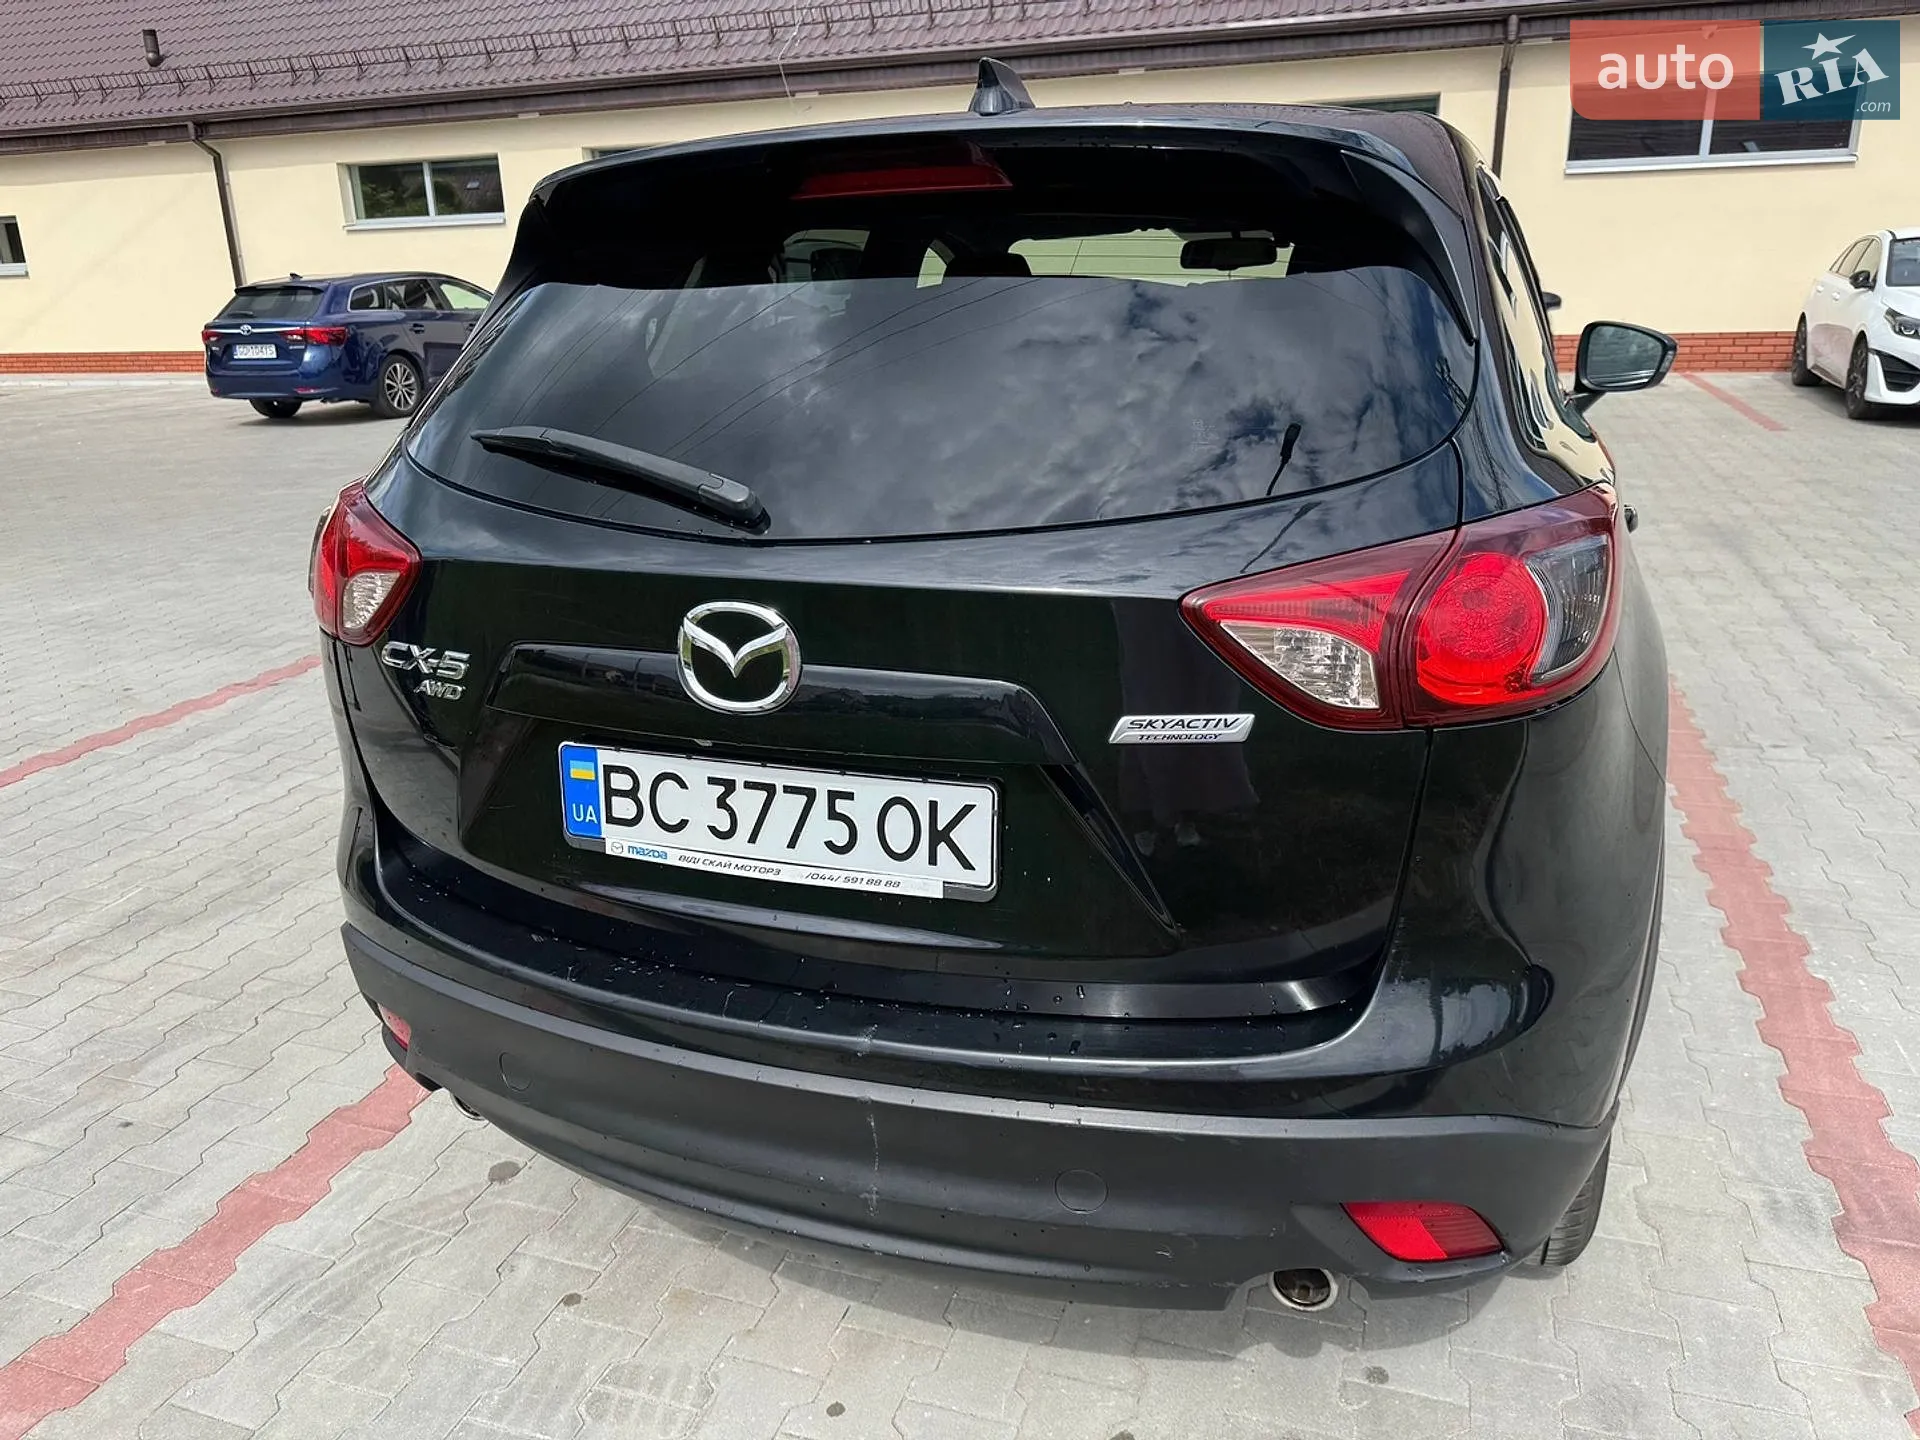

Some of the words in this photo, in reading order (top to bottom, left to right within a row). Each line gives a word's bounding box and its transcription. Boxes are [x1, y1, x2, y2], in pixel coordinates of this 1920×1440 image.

[381, 640, 472, 680] CX-5
[413, 679, 466, 700] AWD
[1127, 717, 1240, 730] SKYACTIV
[1138, 733, 1222, 741] TECHNOLOGY
[571, 802, 599, 824] UA
[602, 764, 690, 833] BC
[706, 775, 859, 856] 3775
[876, 796, 977, 872] OK
[627, 844, 668, 860] mazda
[842, 876, 864, 885] 591
